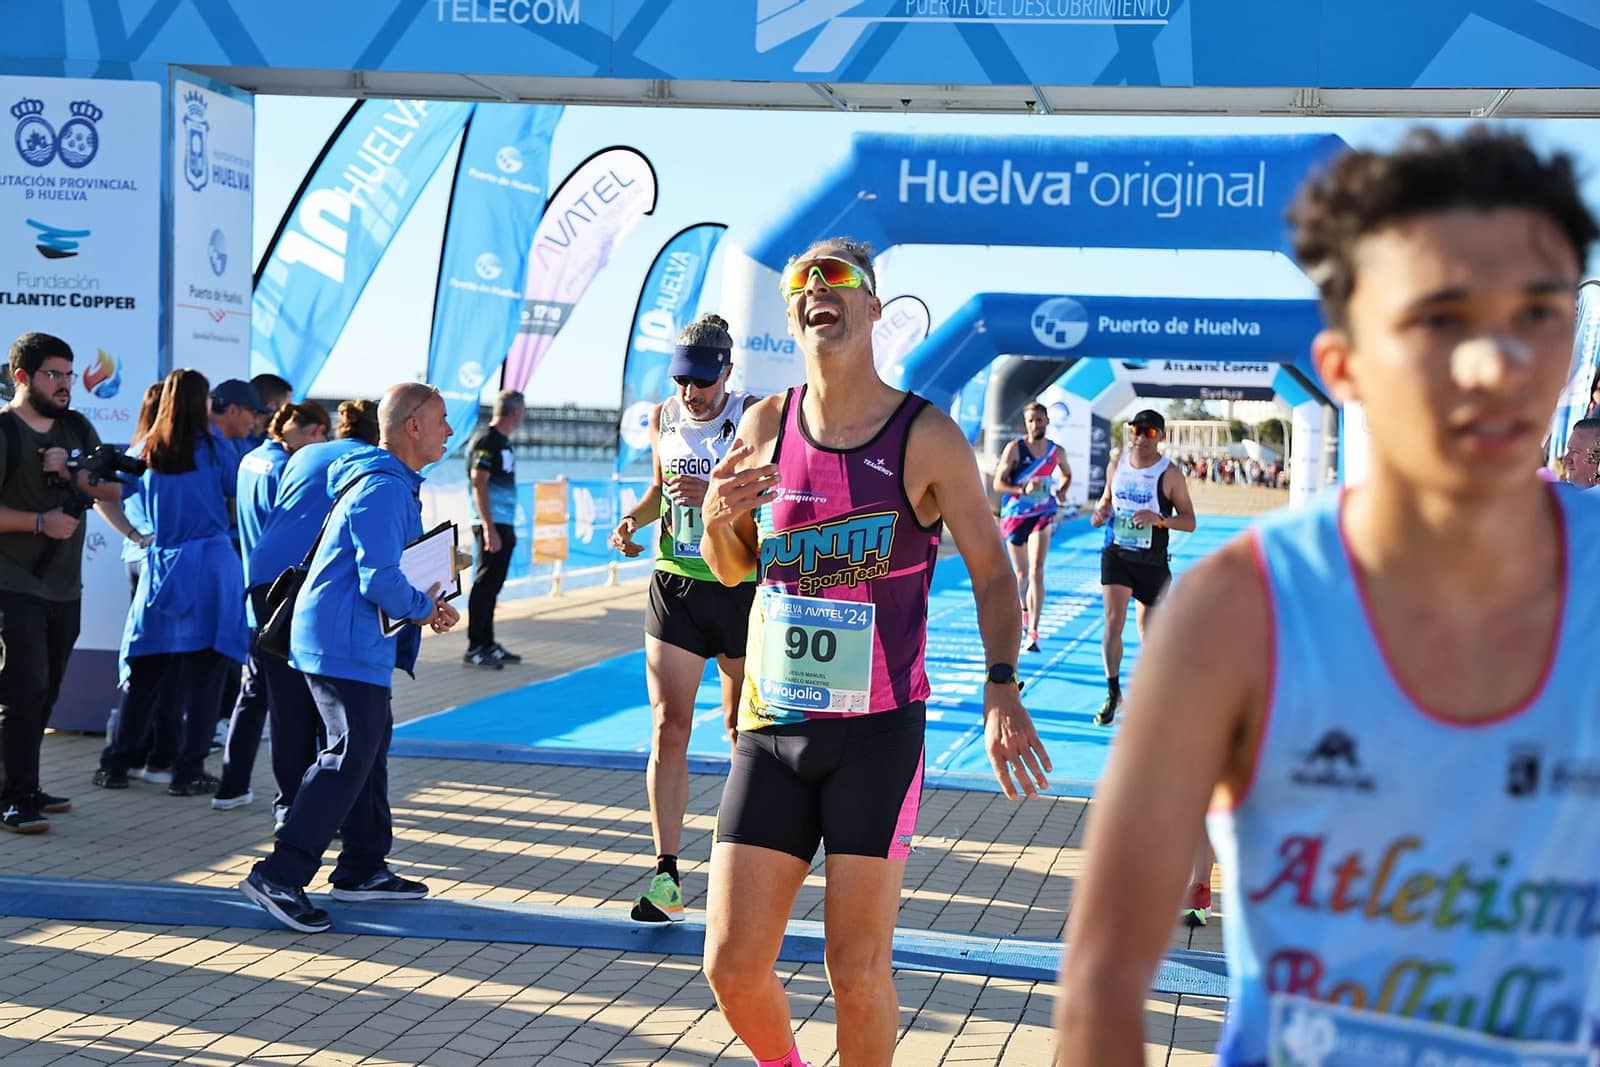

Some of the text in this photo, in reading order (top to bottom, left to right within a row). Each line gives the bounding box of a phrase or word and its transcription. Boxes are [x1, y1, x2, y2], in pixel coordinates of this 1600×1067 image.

[436, 0, 580, 24] TELECOM
[906, 0, 1170, 17] PUERTA DEL DESCUBRIMIENTO
[60, 177, 137, 191] PROVINCIAL
[900, 159, 1265, 218] Huelva original
[38, 189, 87, 201] HUELVA
[535, 170, 635, 272] AVATEL
[16, 271, 99, 289] Fundación
[659, 251, 691, 314] HUELVA
[70, 292, 136, 310] COPPER
[1098, 316, 1260, 336] Puerto de Huelva
[1163, 360, 1218, 372] ATLANTIC
[665, 458, 710, 475] SERGIO
[804, 606, 842, 618] AVATEL
[785, 626, 837, 663] 90
